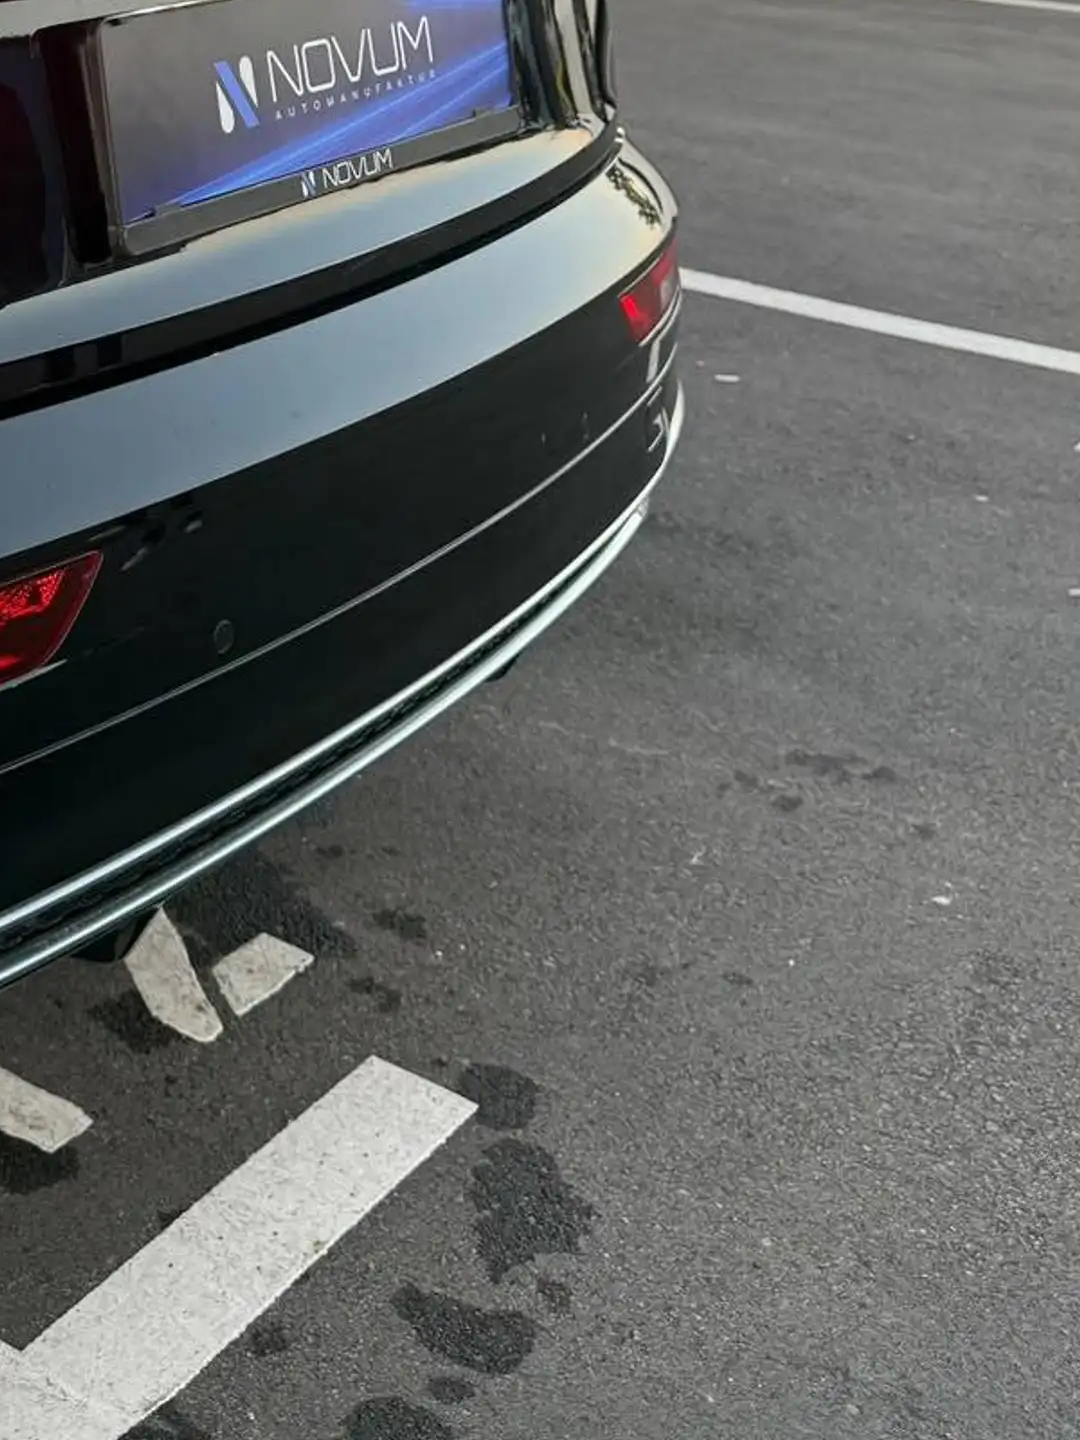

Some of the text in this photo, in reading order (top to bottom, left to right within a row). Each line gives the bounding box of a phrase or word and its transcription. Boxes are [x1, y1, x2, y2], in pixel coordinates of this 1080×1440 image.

[266, 15, 434, 103] NOVUM
[275, 68, 436, 120] AUTOMANUFAKTUR
[322, 147, 393, 189] NOVUM
